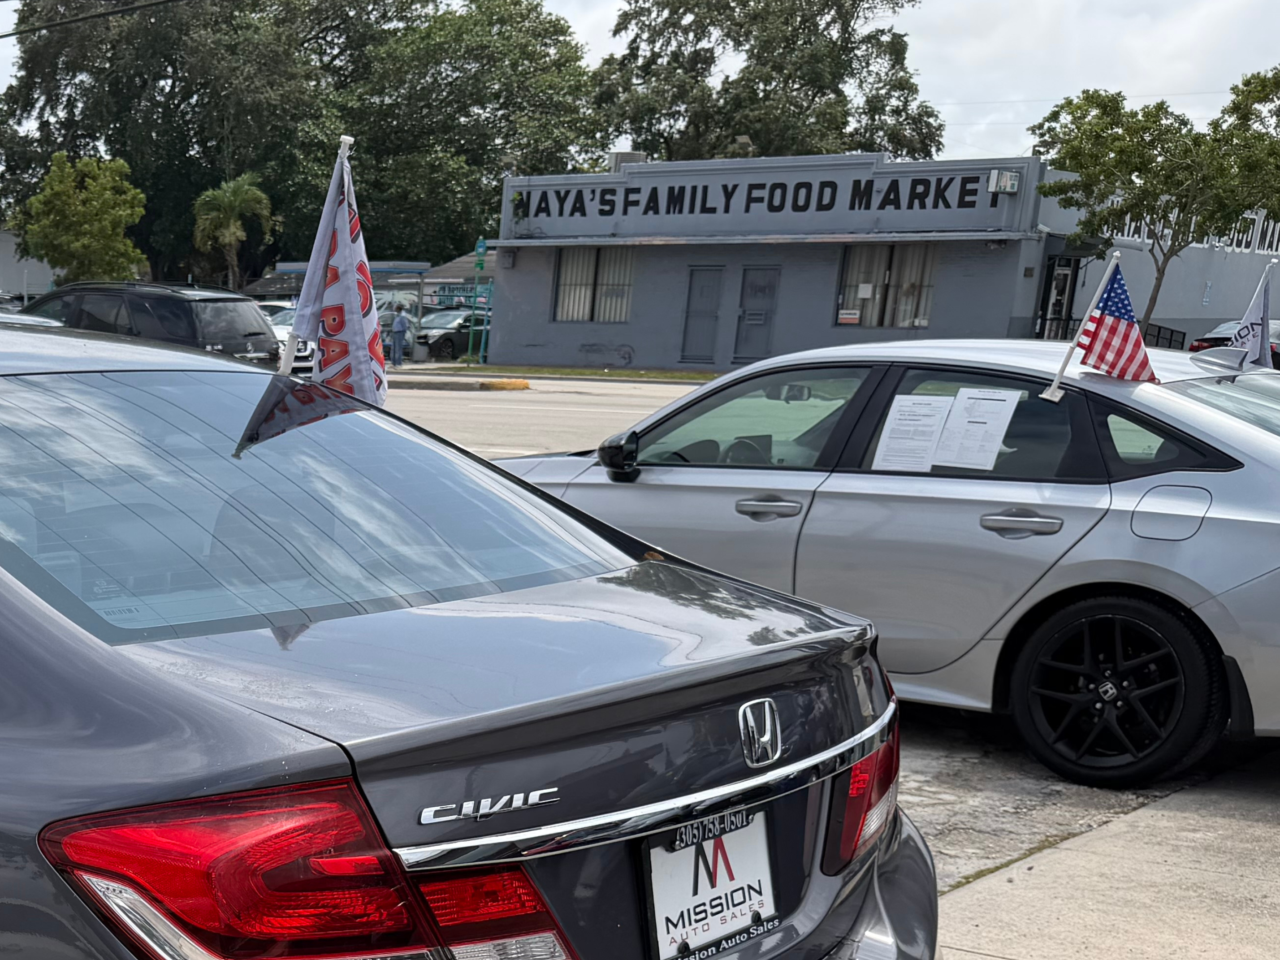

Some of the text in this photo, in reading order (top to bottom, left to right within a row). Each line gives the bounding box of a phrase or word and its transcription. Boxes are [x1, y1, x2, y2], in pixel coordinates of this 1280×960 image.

[622, 184, 740, 217] FAMILY
[744, 180, 838, 214] FOOD
[418, 787, 561, 825] CIVIC
[664, 879, 764, 935] MISSION
[669, 899, 765, 947] AUTO SALES
[719, 933, 748, 952] Auto
[750, 918, 780, 938] Sales
